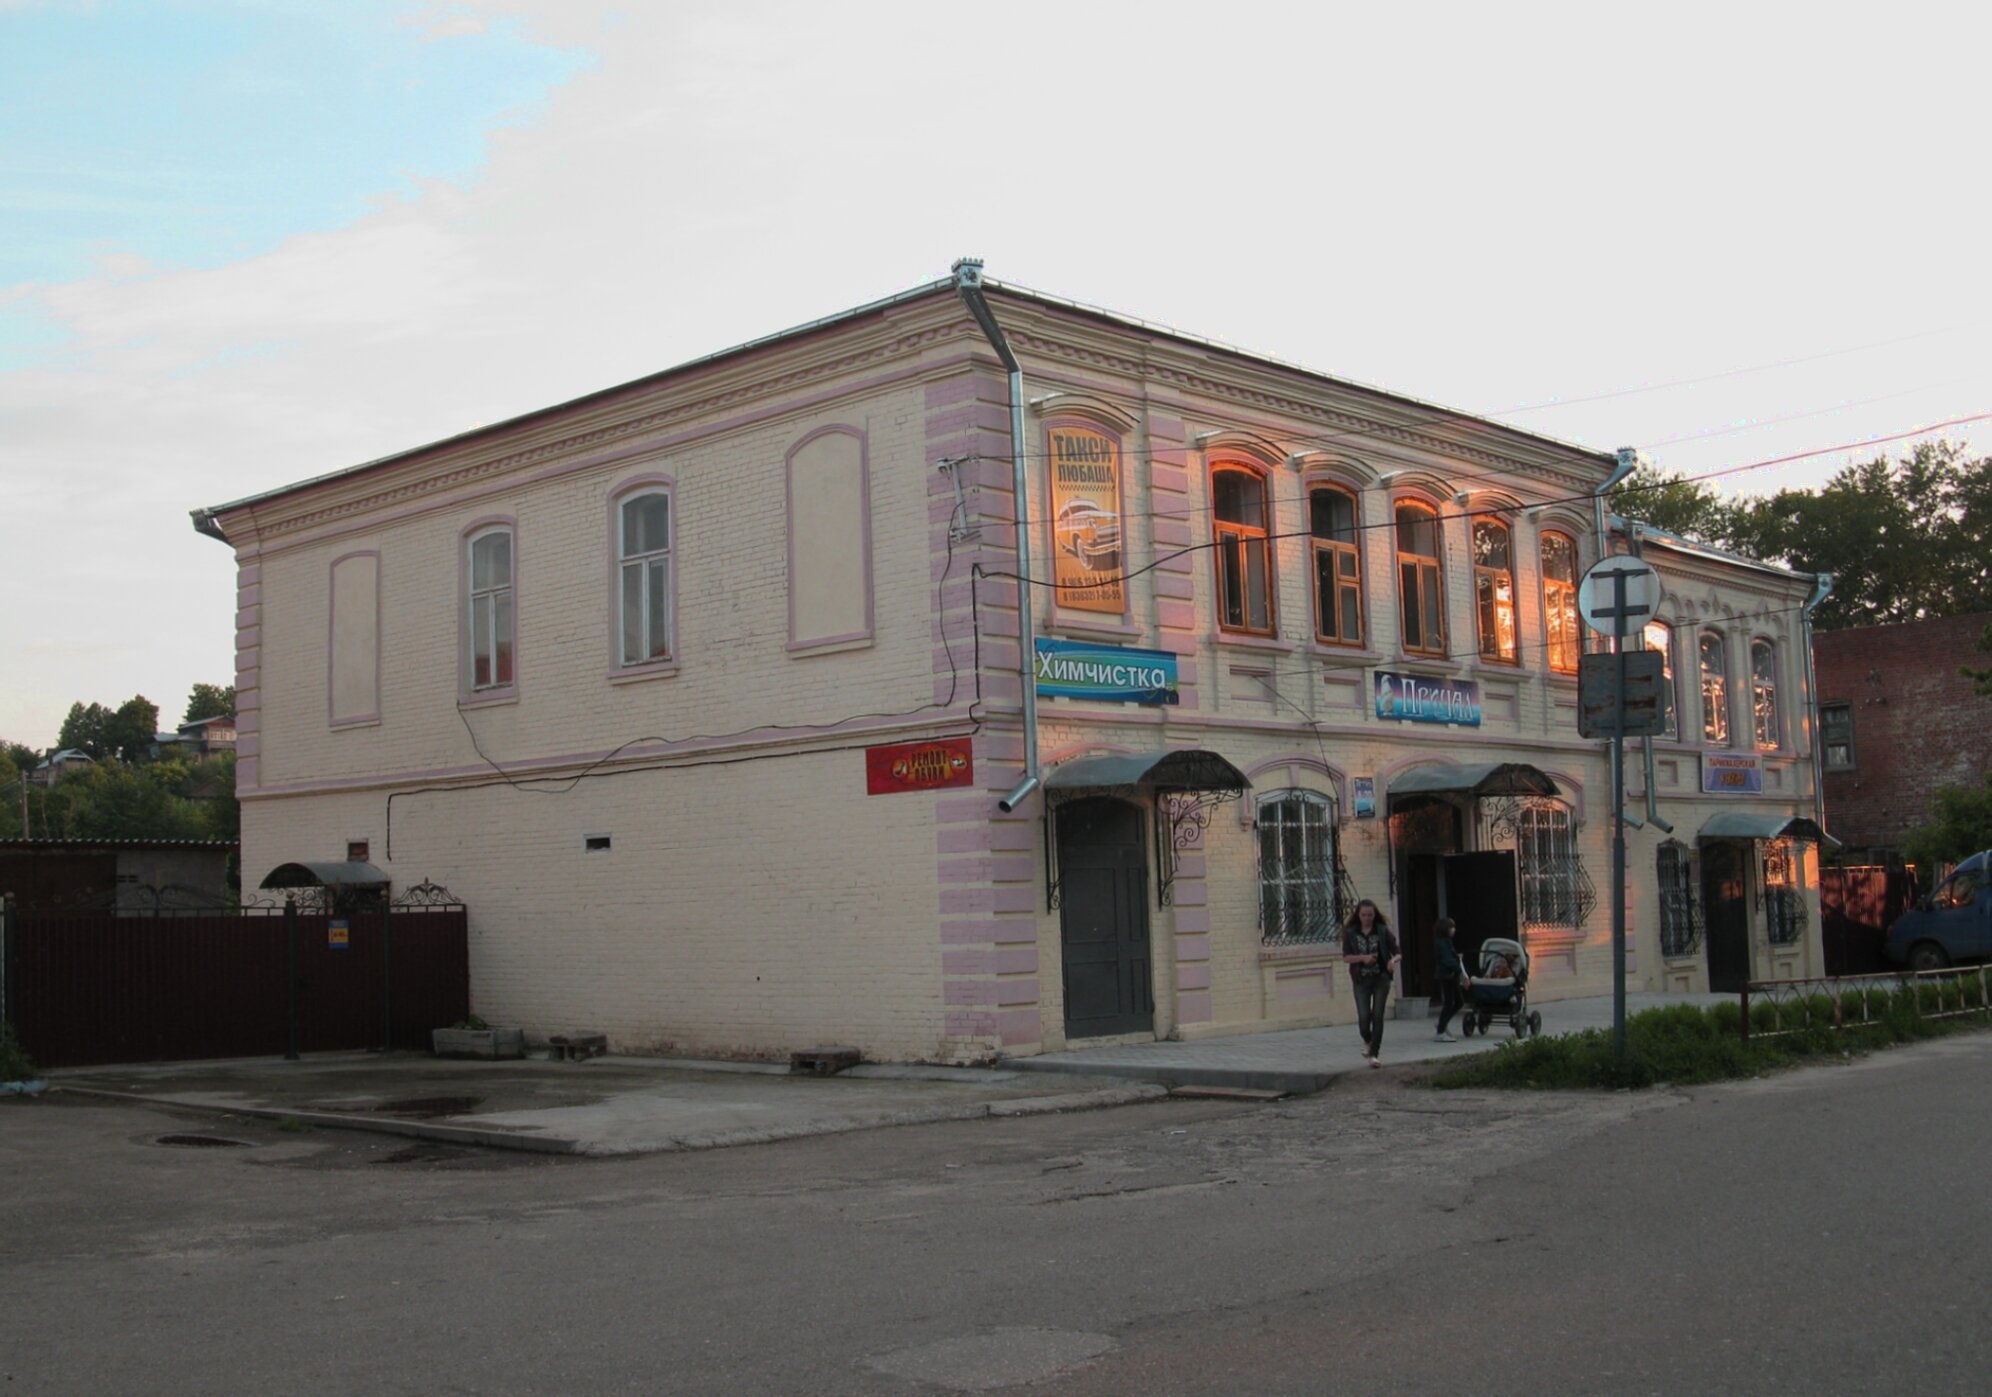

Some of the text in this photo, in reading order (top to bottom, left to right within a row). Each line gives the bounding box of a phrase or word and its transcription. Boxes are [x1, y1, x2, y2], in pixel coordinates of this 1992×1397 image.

[1054, 435, 1112, 463] ТАКСИ
[1058, 464, 1114, 483] ЛЮБАША
[1038, 651, 1165, 688] Химчистка
[911, 750, 946, 768] РЕМОНТ
[915, 766, 945, 781] ОБУВИ
